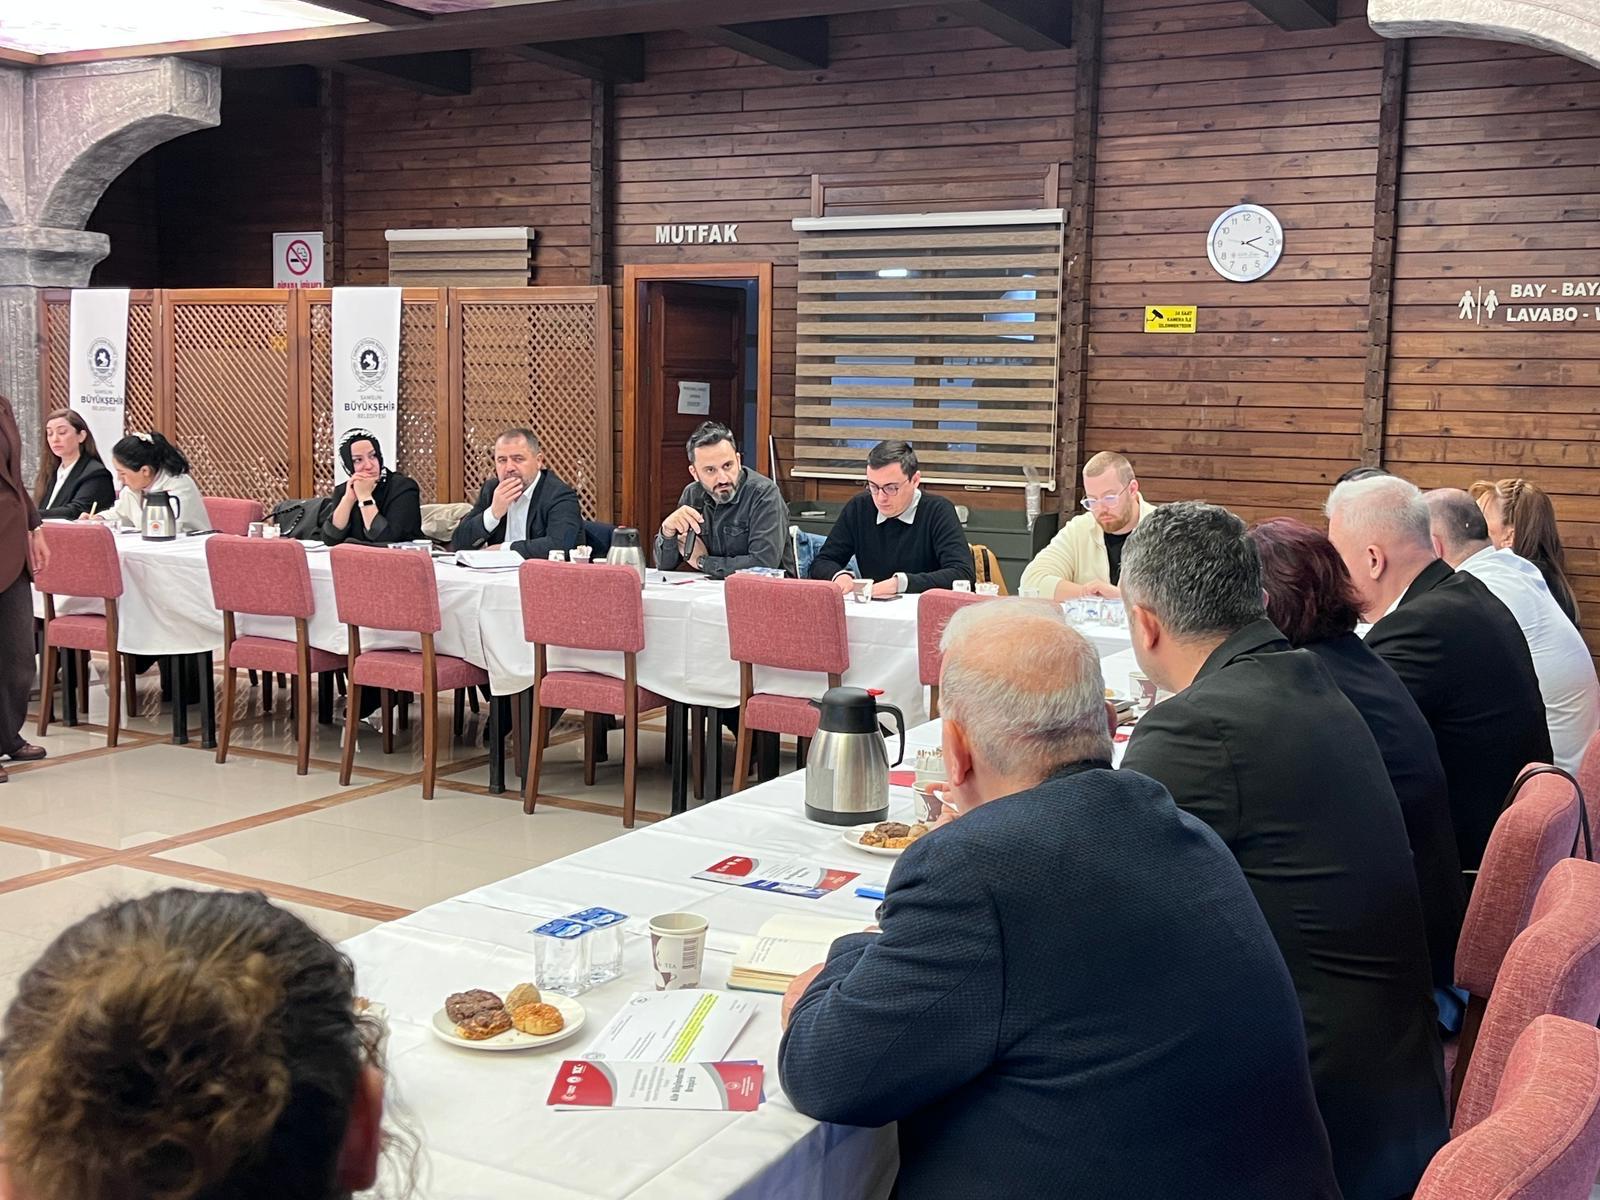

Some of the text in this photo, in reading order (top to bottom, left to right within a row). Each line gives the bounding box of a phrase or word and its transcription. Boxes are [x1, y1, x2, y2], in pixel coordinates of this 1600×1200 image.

[1243, 213, 1251, 222] 12
[655, 224, 738, 244] MUTFAK
[1222, 227, 1230, 235] 10
[1265, 225, 1272, 234] 2
[1217, 240, 1223, 249] 9
[1268, 238, 1275, 247] 3
[1221, 252, 1227, 261] 8
[1229, 260, 1235, 270] 7
[1241, 263, 1248, 273] 6
[1255, 260, 1261, 269] 5
[1510, 283, 1547, 298] BAY
[1561, 281, 1600, 297] BAY
[1506, 307, 1578, 322] LAVABO
[80, 394, 124, 406] BÜYÜKŞEHİR
[344, 401, 395, 413] BÜYÜKŞEHİR
